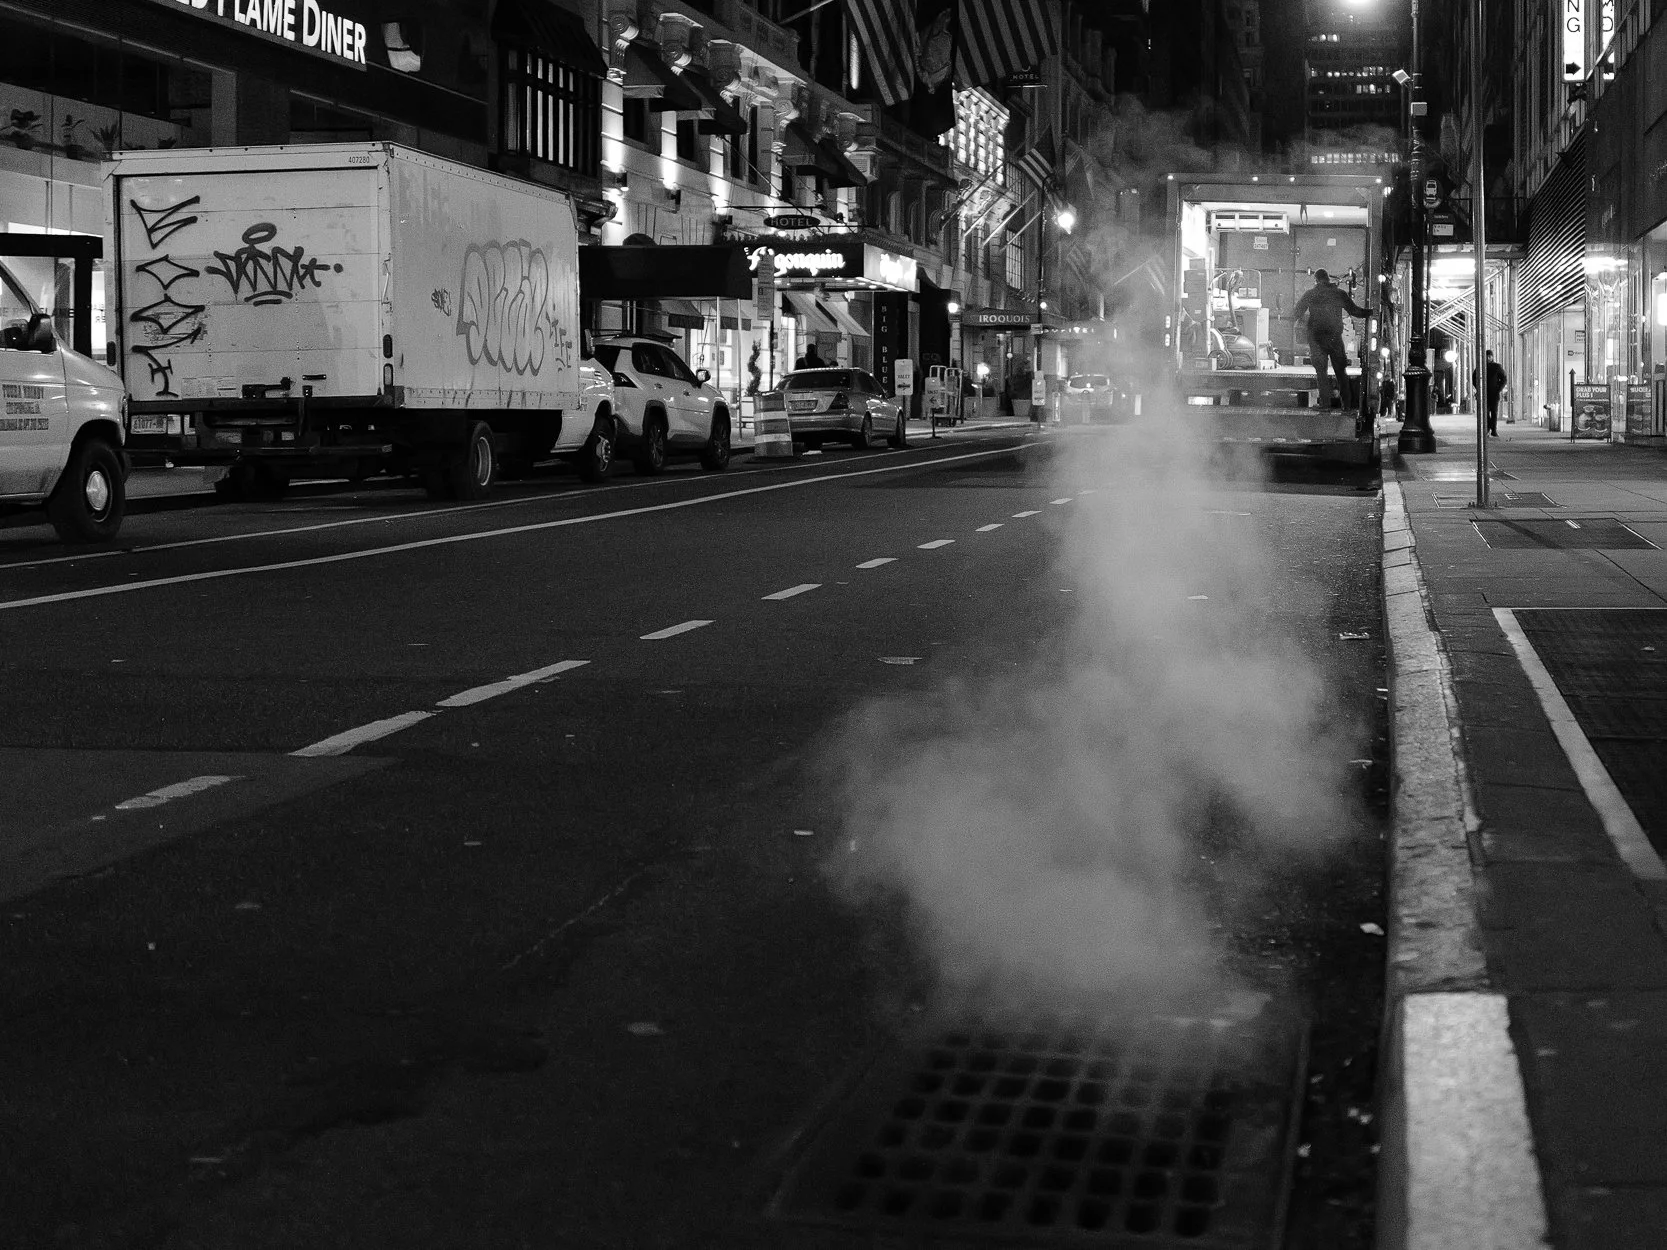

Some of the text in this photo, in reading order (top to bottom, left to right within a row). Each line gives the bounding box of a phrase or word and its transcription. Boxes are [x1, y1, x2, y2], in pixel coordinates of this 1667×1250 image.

[770, 217, 813, 227] HOTEL
[978, 314, 1031, 324] IROQUOIS
[881, 345, 889, 384] BLUE
